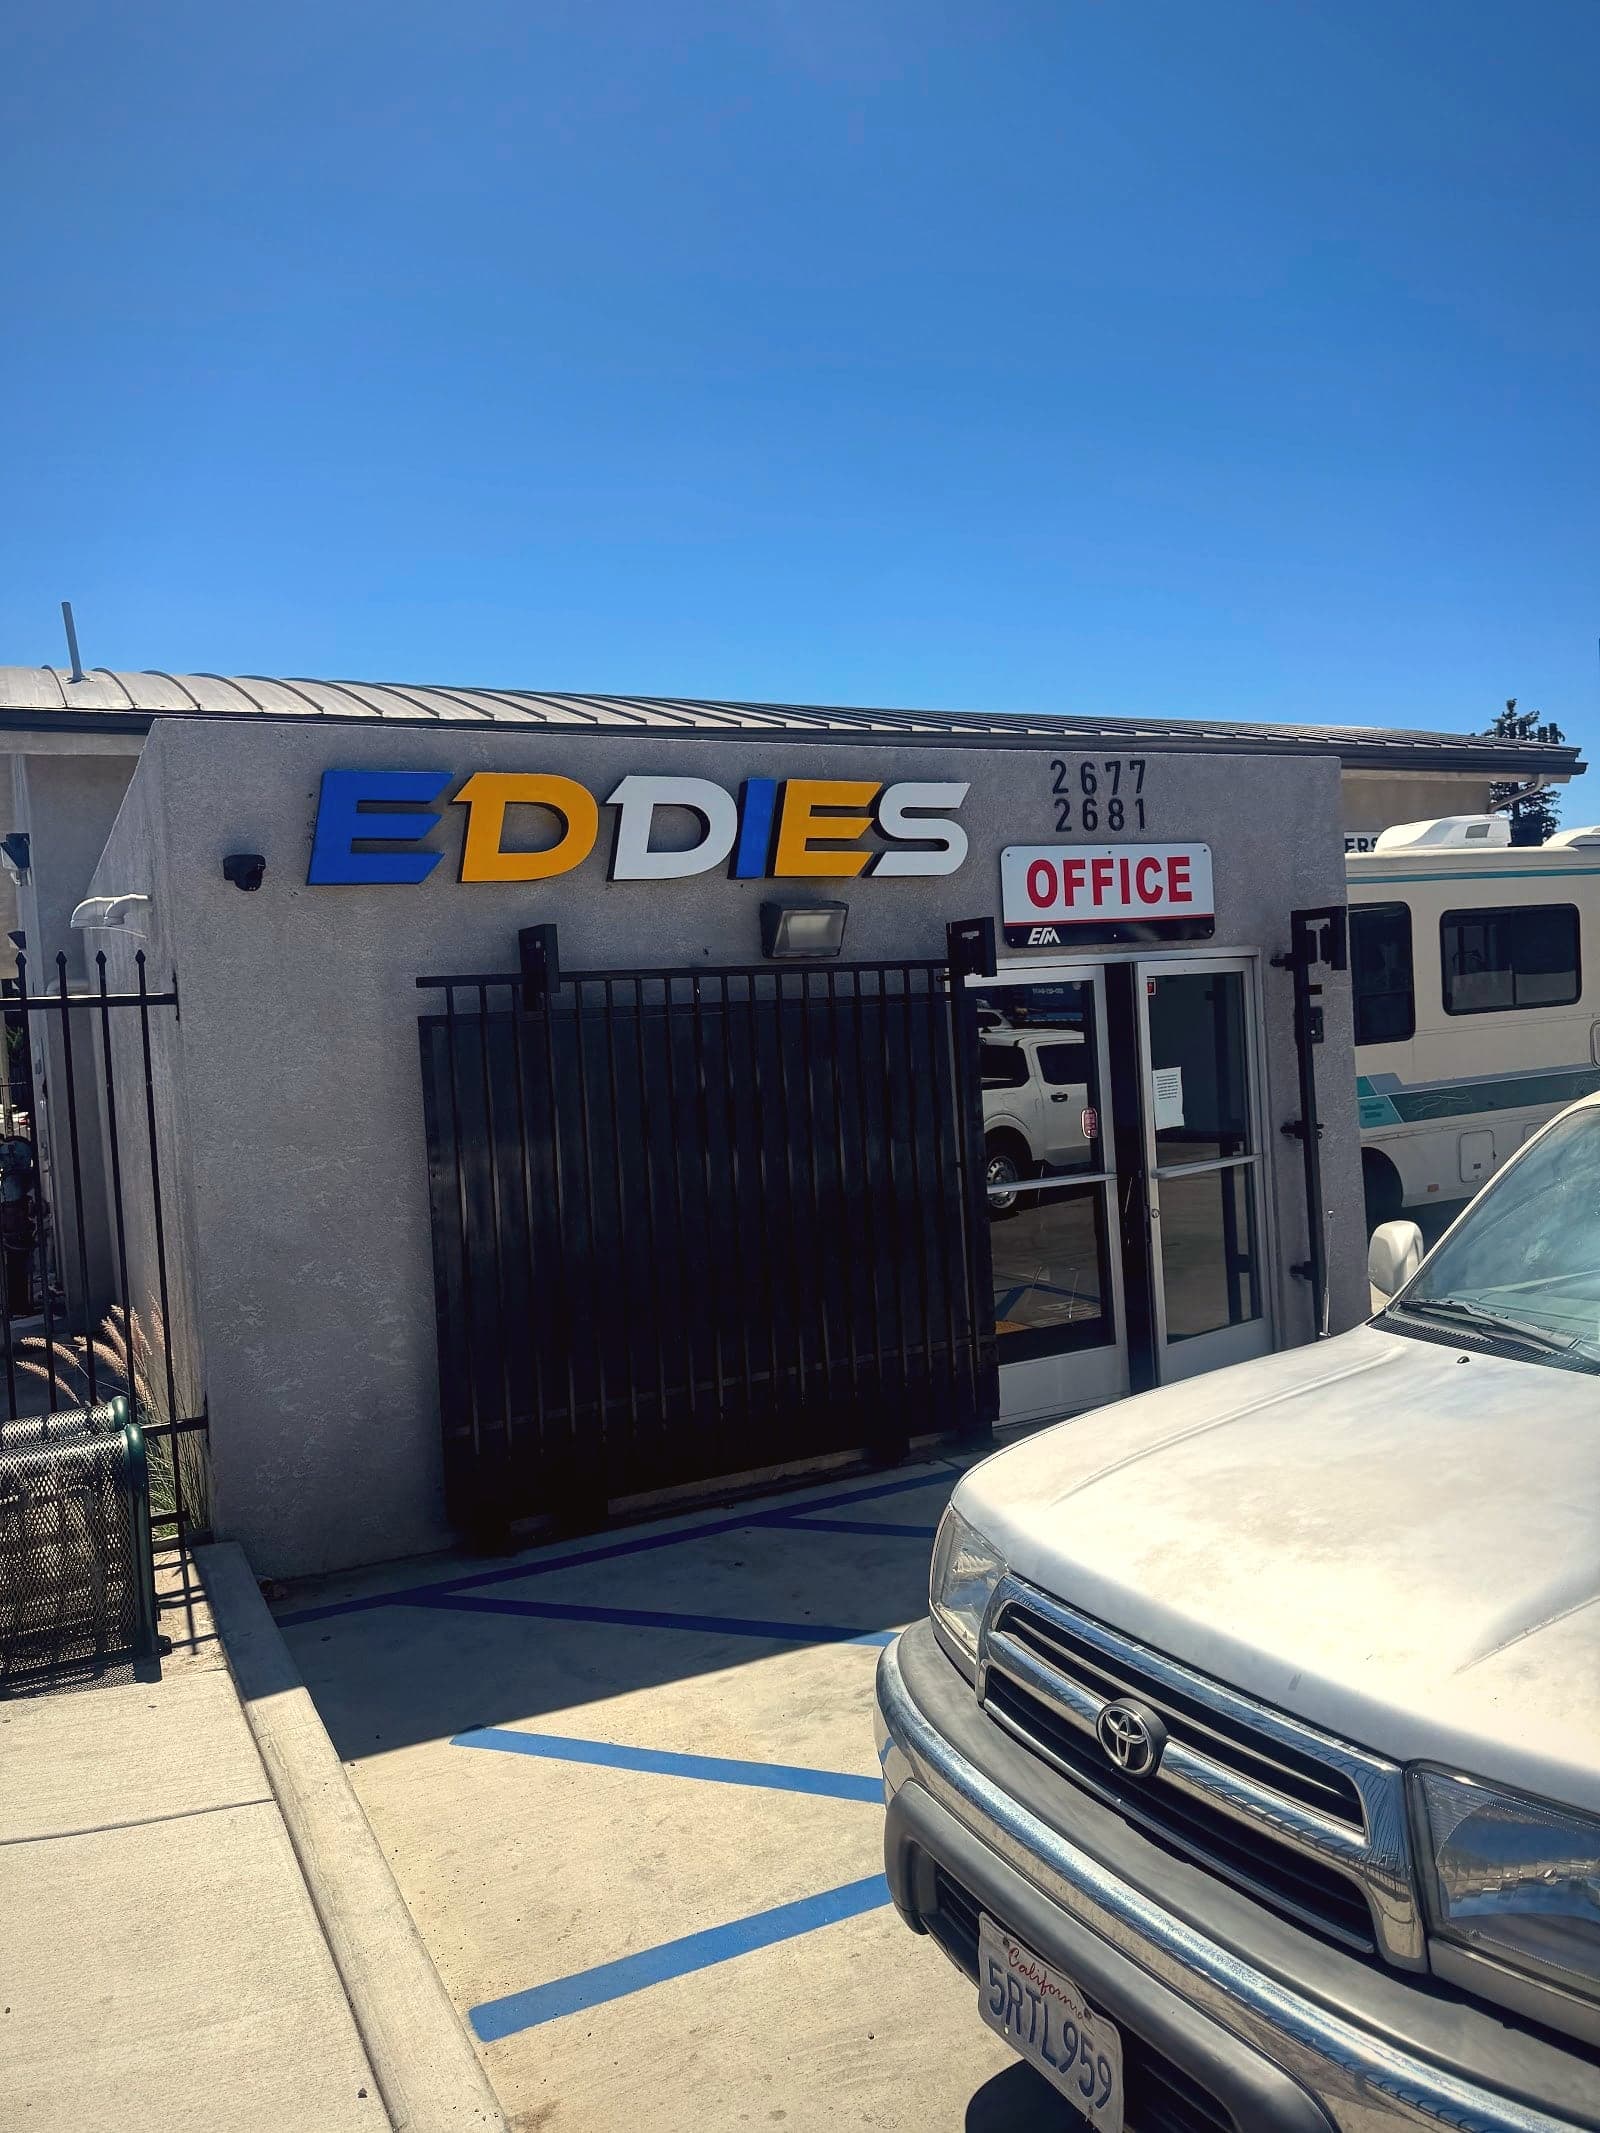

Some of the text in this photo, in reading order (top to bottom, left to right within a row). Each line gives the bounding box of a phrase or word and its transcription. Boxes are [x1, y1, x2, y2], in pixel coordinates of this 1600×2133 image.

[1050, 759, 1146, 796] 2677
[307, 770, 970, 885] EDDIES
[1053, 798, 1146, 832] 2681
[1026, 856, 1193, 909] OFFICE
[988, 1958, 1112, 2109] 5RTL959
